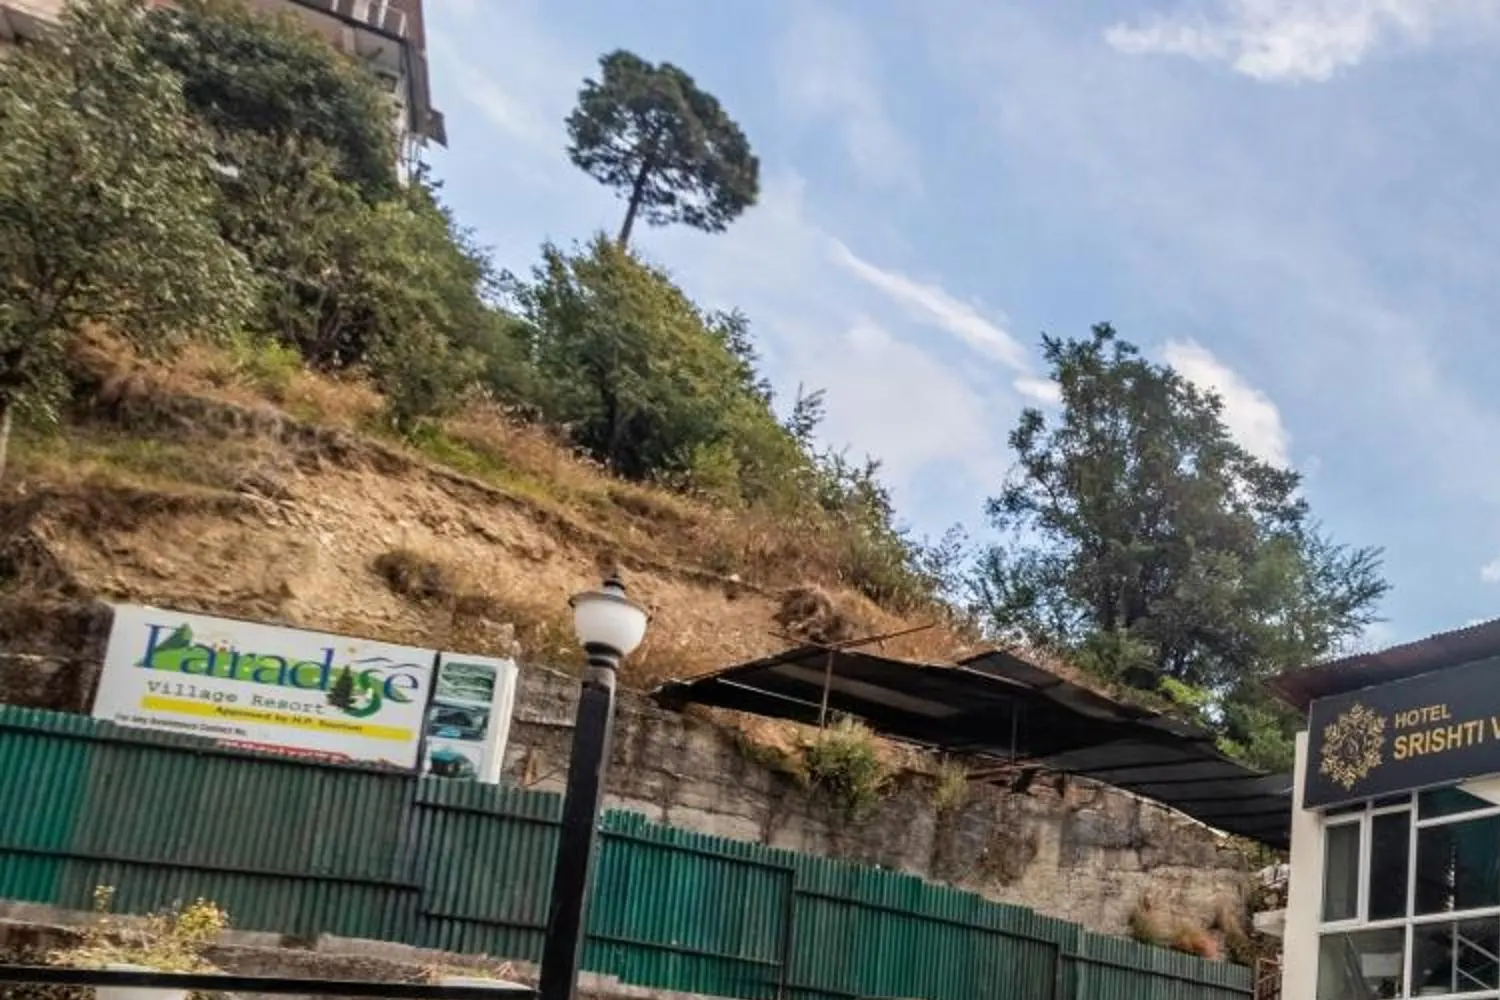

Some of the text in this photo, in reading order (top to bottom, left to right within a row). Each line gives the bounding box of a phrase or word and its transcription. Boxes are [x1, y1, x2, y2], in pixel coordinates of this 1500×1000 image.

[147, 680, 326, 714] Village Resort
[1394, 704, 1452, 728] HOTEL
[1393, 719, 1484, 760] SRISHTI
